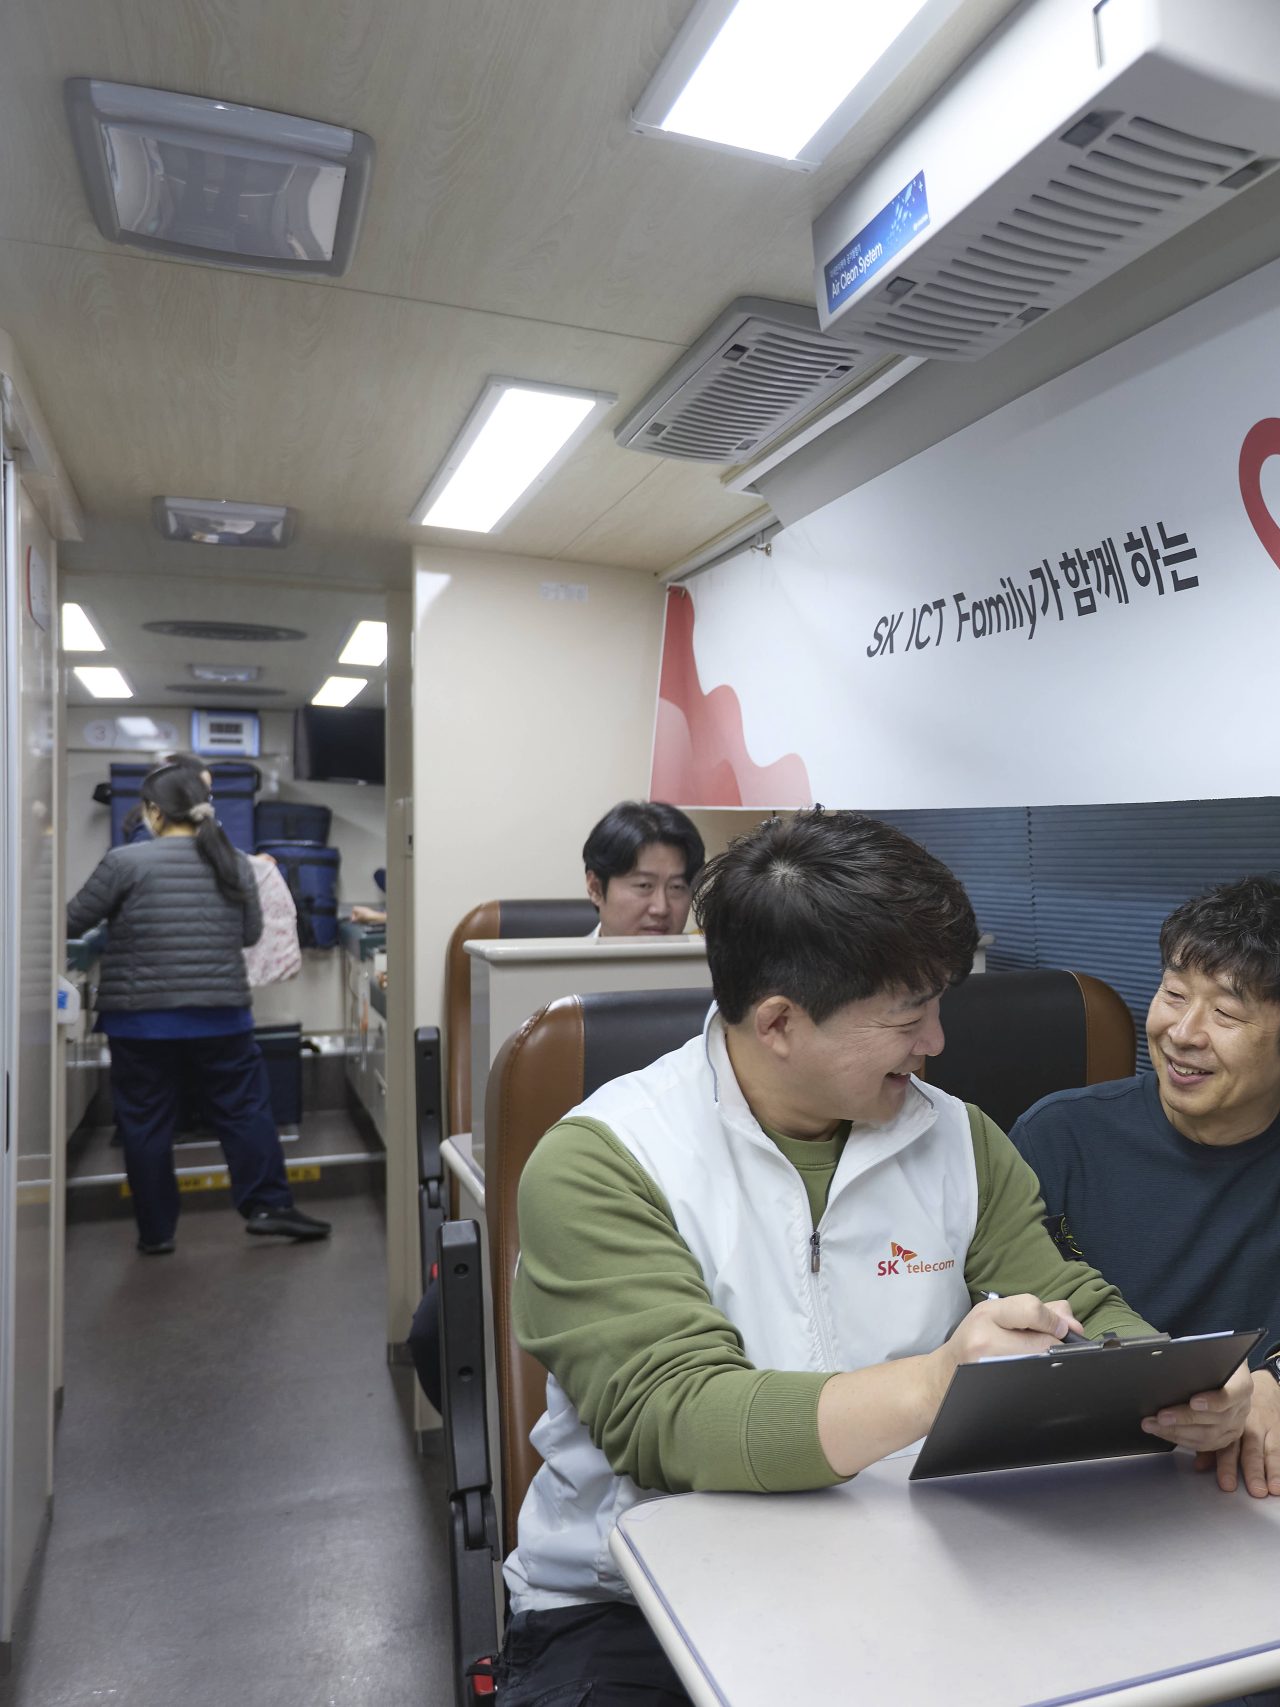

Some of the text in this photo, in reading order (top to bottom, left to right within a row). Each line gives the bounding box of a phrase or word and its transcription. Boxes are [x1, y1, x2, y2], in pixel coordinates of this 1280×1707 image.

[832, 279, 840, 298] Air
[840, 265, 859, 289] Clean
[858, 242, 883, 275] System
[867, 521, 1199, 657] SK ICT Family가 함께 하는
[877, 1260, 955, 1276] SK telecom
